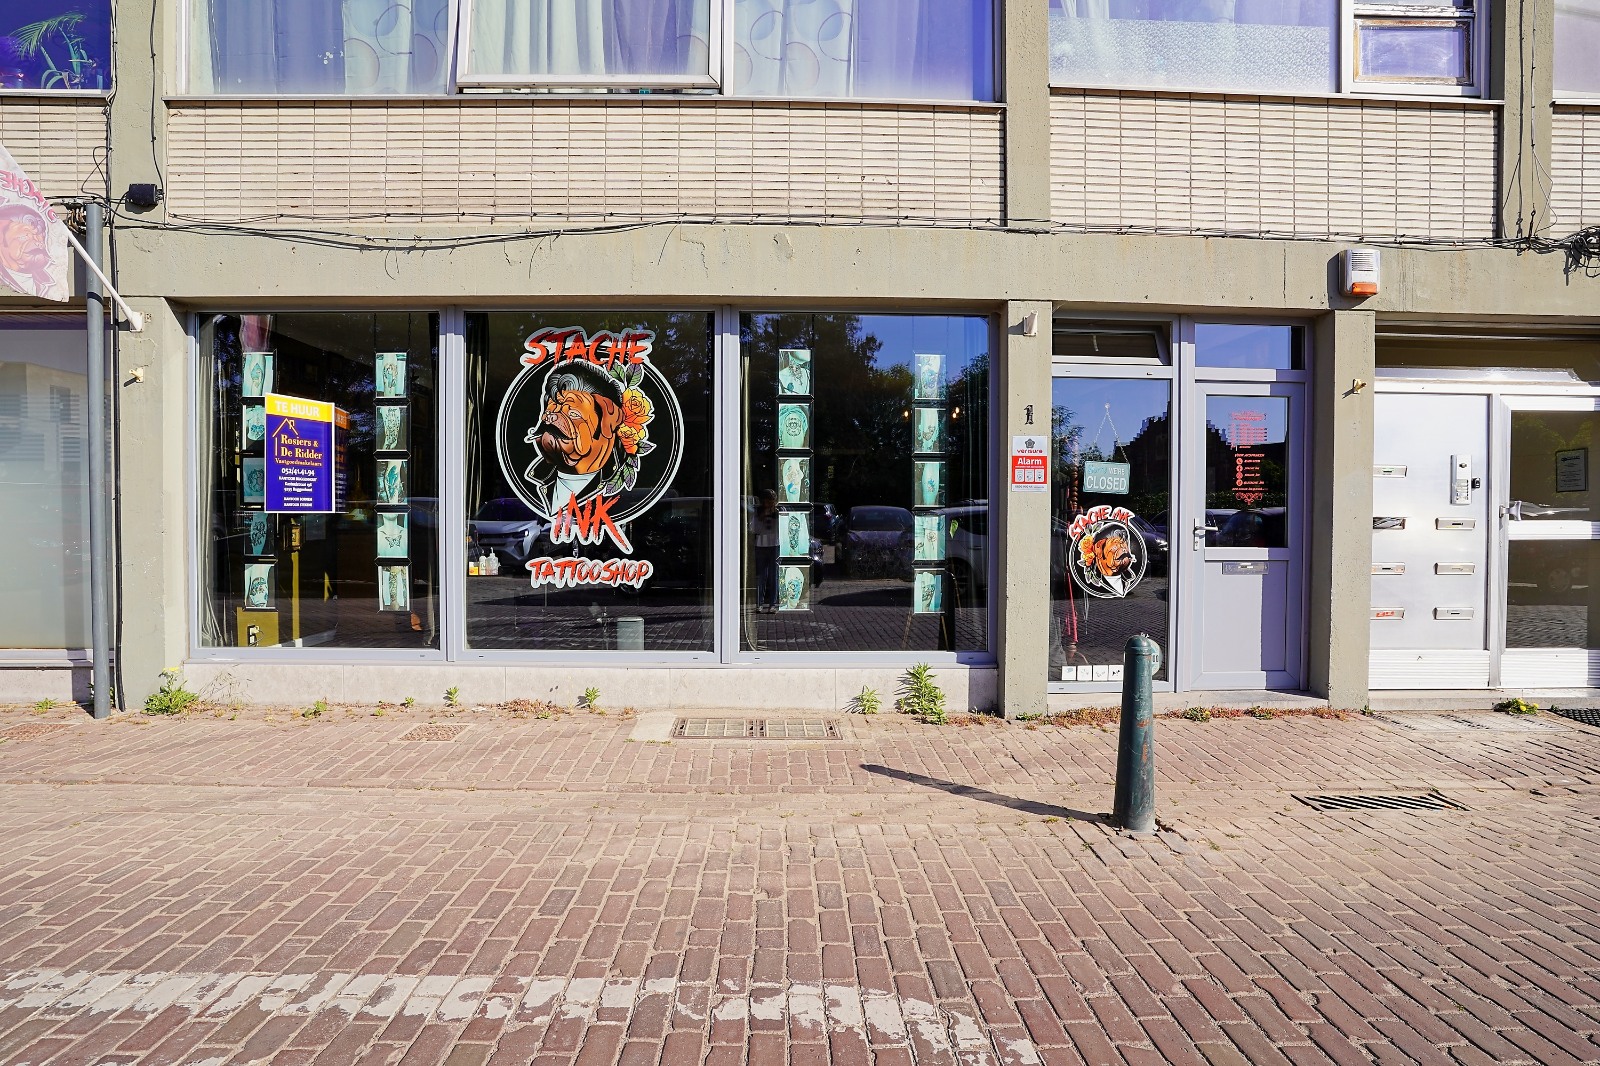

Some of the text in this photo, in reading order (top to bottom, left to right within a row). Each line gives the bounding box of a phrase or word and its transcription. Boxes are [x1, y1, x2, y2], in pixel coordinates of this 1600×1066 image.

[524, 329, 653, 371] STACHE
[274, 400, 320, 417] TE HUUR
[1023, 404, 1034, 425] 1
[280, 433, 312, 447] Rosiers
[280, 446, 293, 457] De
[294, 447, 323, 460] Ridder
[1017, 457, 1042, 465] Alarm
[1086, 475, 1127, 491] CLOSED
[553, 490, 630, 551] INK
[1071, 506, 1134, 541] STACHE INK
[529, 559, 650, 586] TATTOOSHOP
